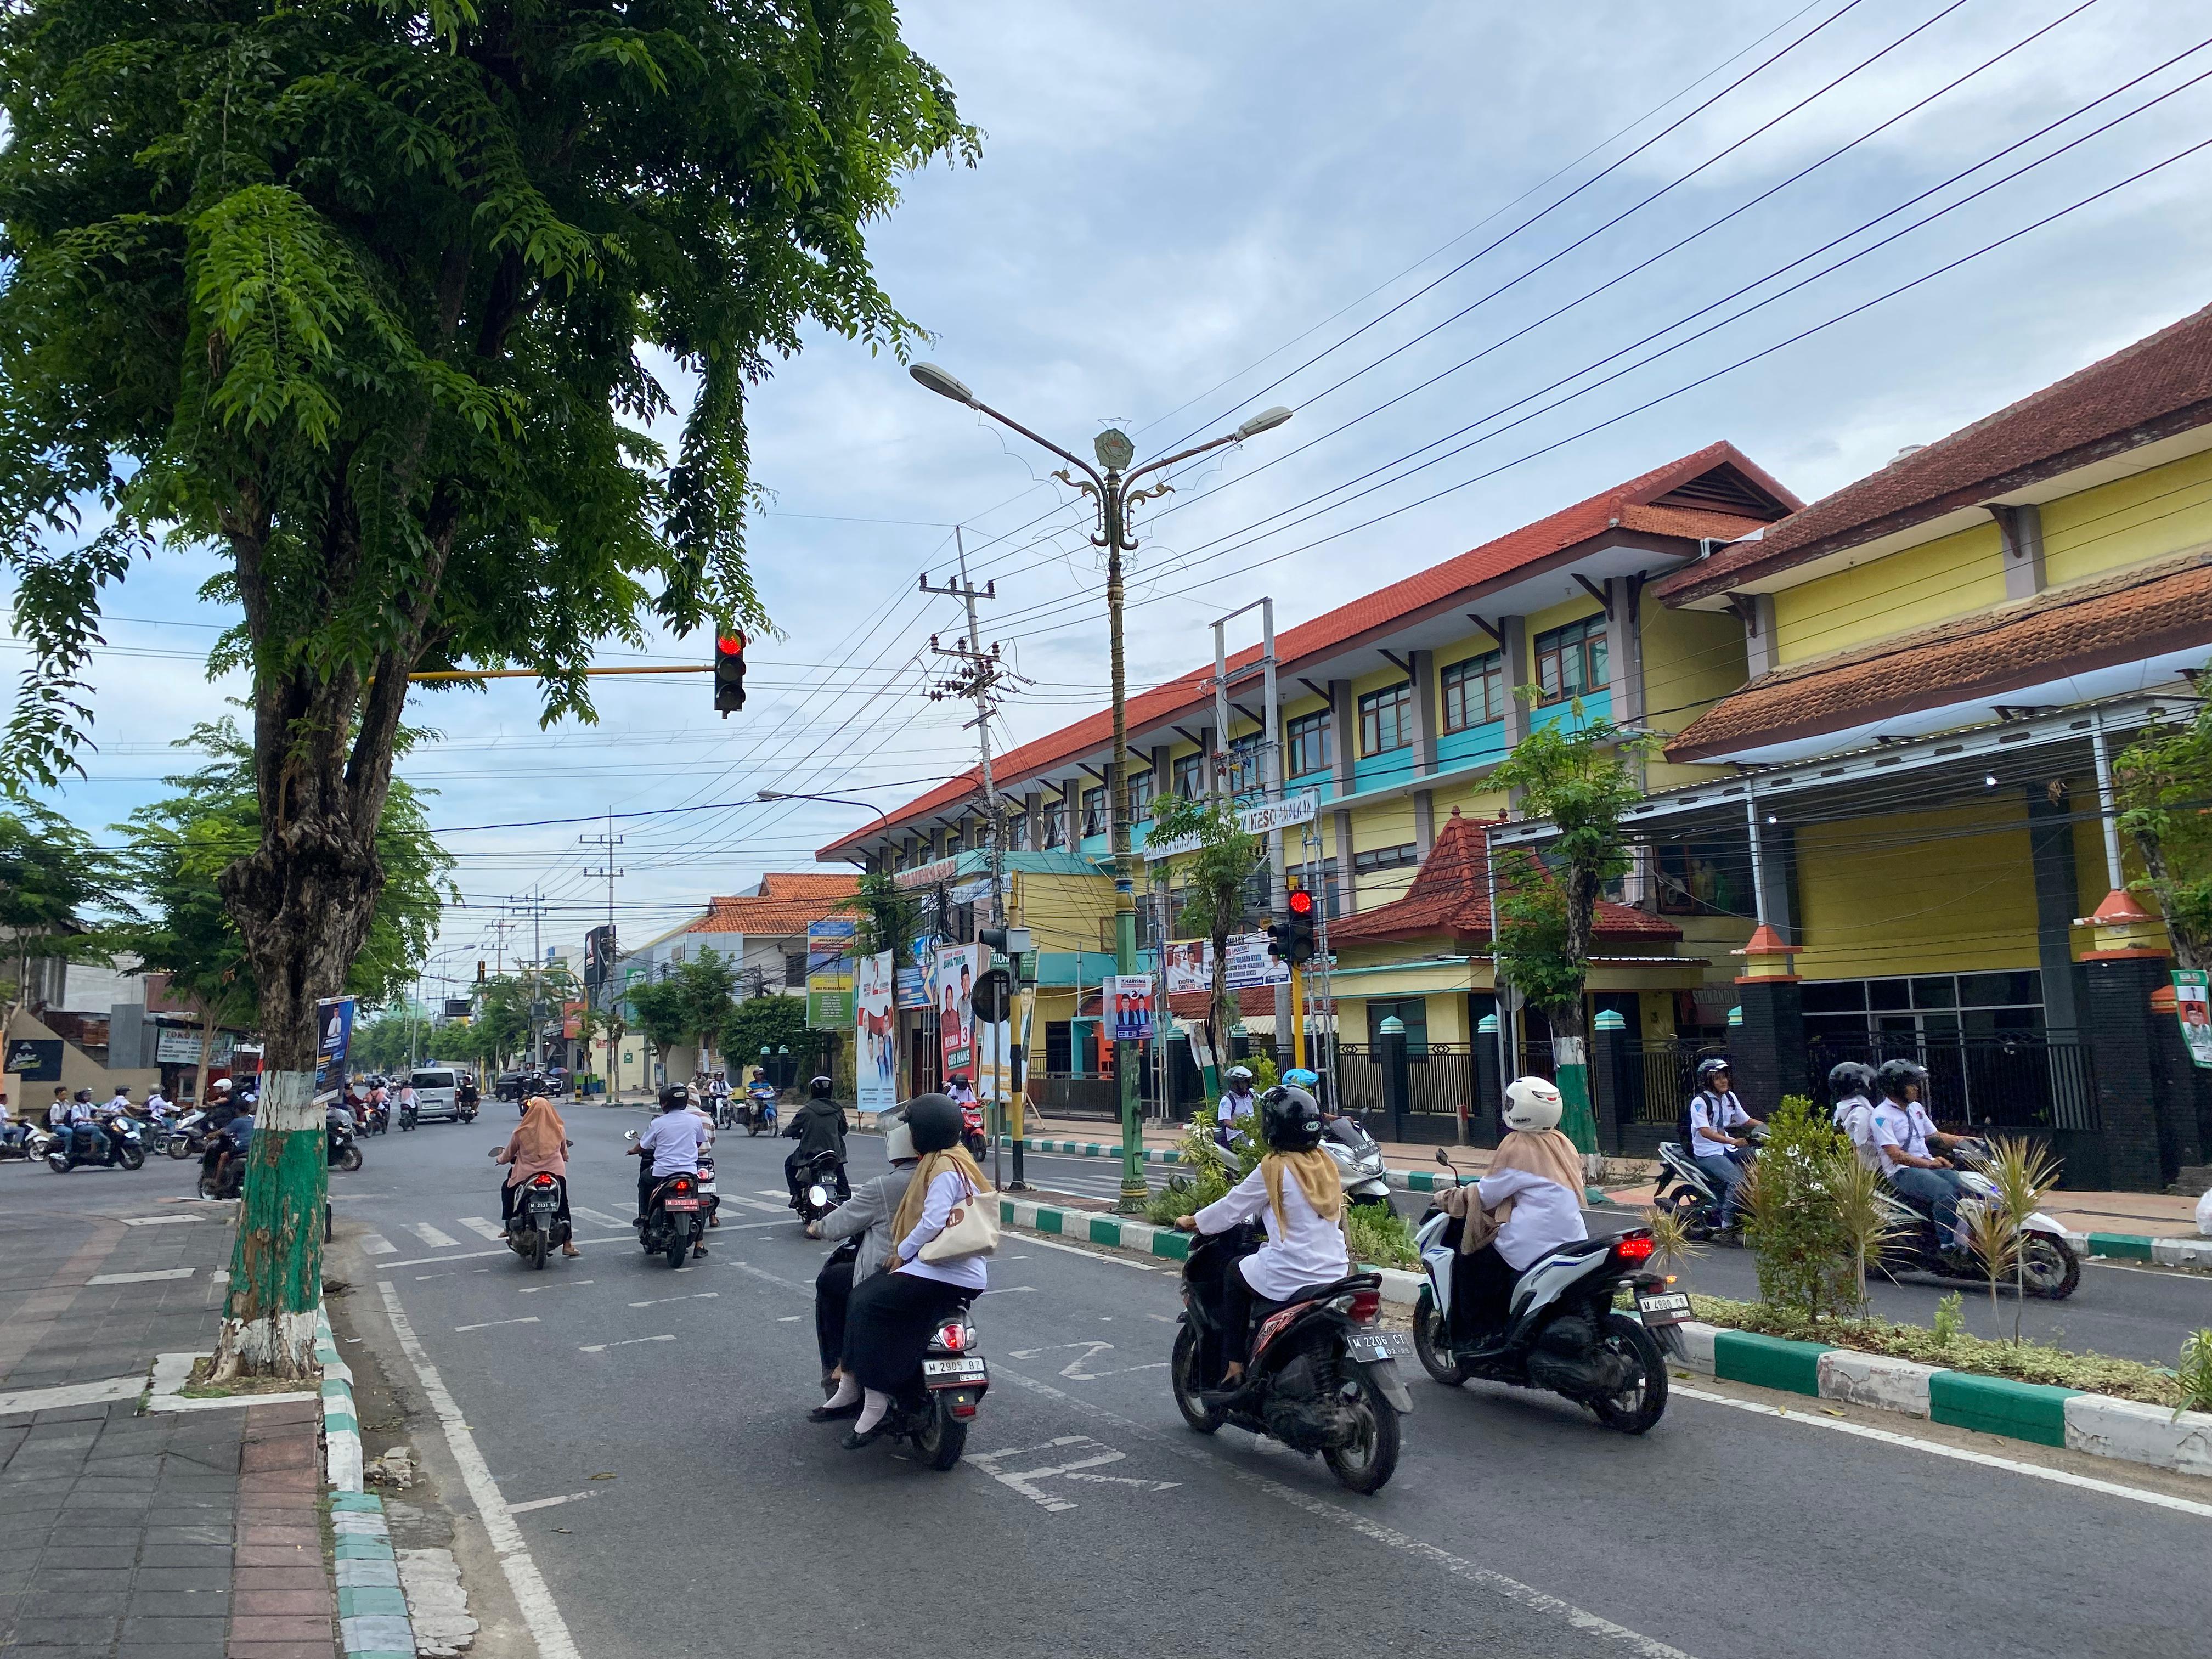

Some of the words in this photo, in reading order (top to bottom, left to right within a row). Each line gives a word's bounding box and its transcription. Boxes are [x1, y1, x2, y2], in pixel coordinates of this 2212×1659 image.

[943, 958, 953, 969] JAWA
[872, 961, 879, 995] 2
[945, 1034, 958, 1048] RISMA
[963, 1027, 968, 1042] 3
[957, 1049, 970, 1064] HANS
[1655, 1299, 1672, 1310] 4880
[1353, 1339, 1361, 1348] M
[1364, 1335, 1388, 1348] 2206
[1393, 1334, 1404, 1344] CT
[929, 1363, 936, 1373] M
[940, 1361, 963, 1372] 2905
[969, 1361, 981, 1370] BZ
